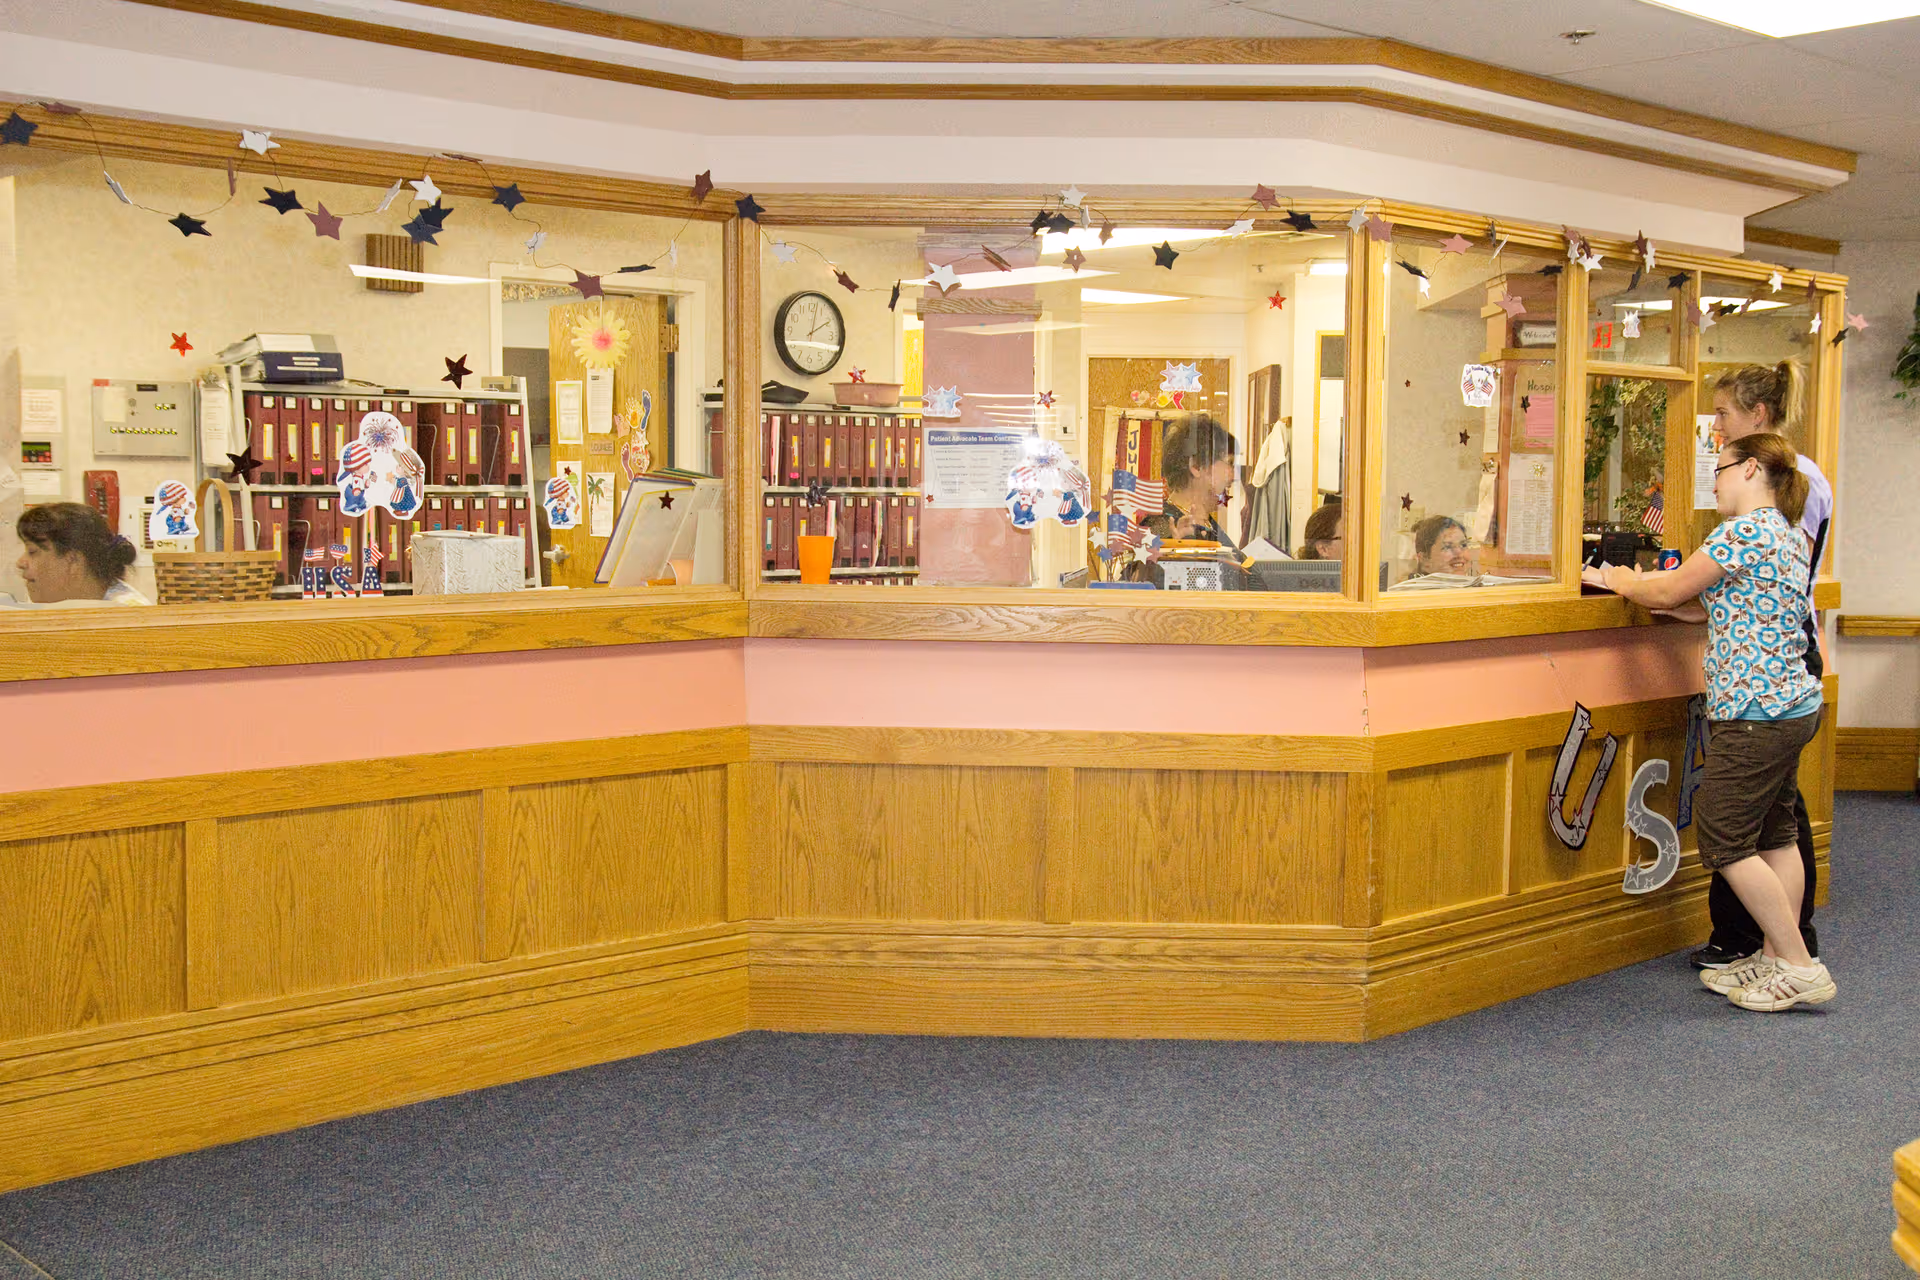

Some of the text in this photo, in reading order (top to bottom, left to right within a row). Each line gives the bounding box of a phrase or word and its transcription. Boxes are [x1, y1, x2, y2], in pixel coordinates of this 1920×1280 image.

[799, 304, 805, 315] 11
[808, 302, 816, 313] 12
[790, 313, 799, 324] 10
[787, 325, 793, 336] 9
[828, 330, 834, 342] 3
[797, 349, 803, 360] 7
[806, 354, 813, 364] 6
[817, 351, 823, 362] 5
[300, 566, 385, 600] USA
